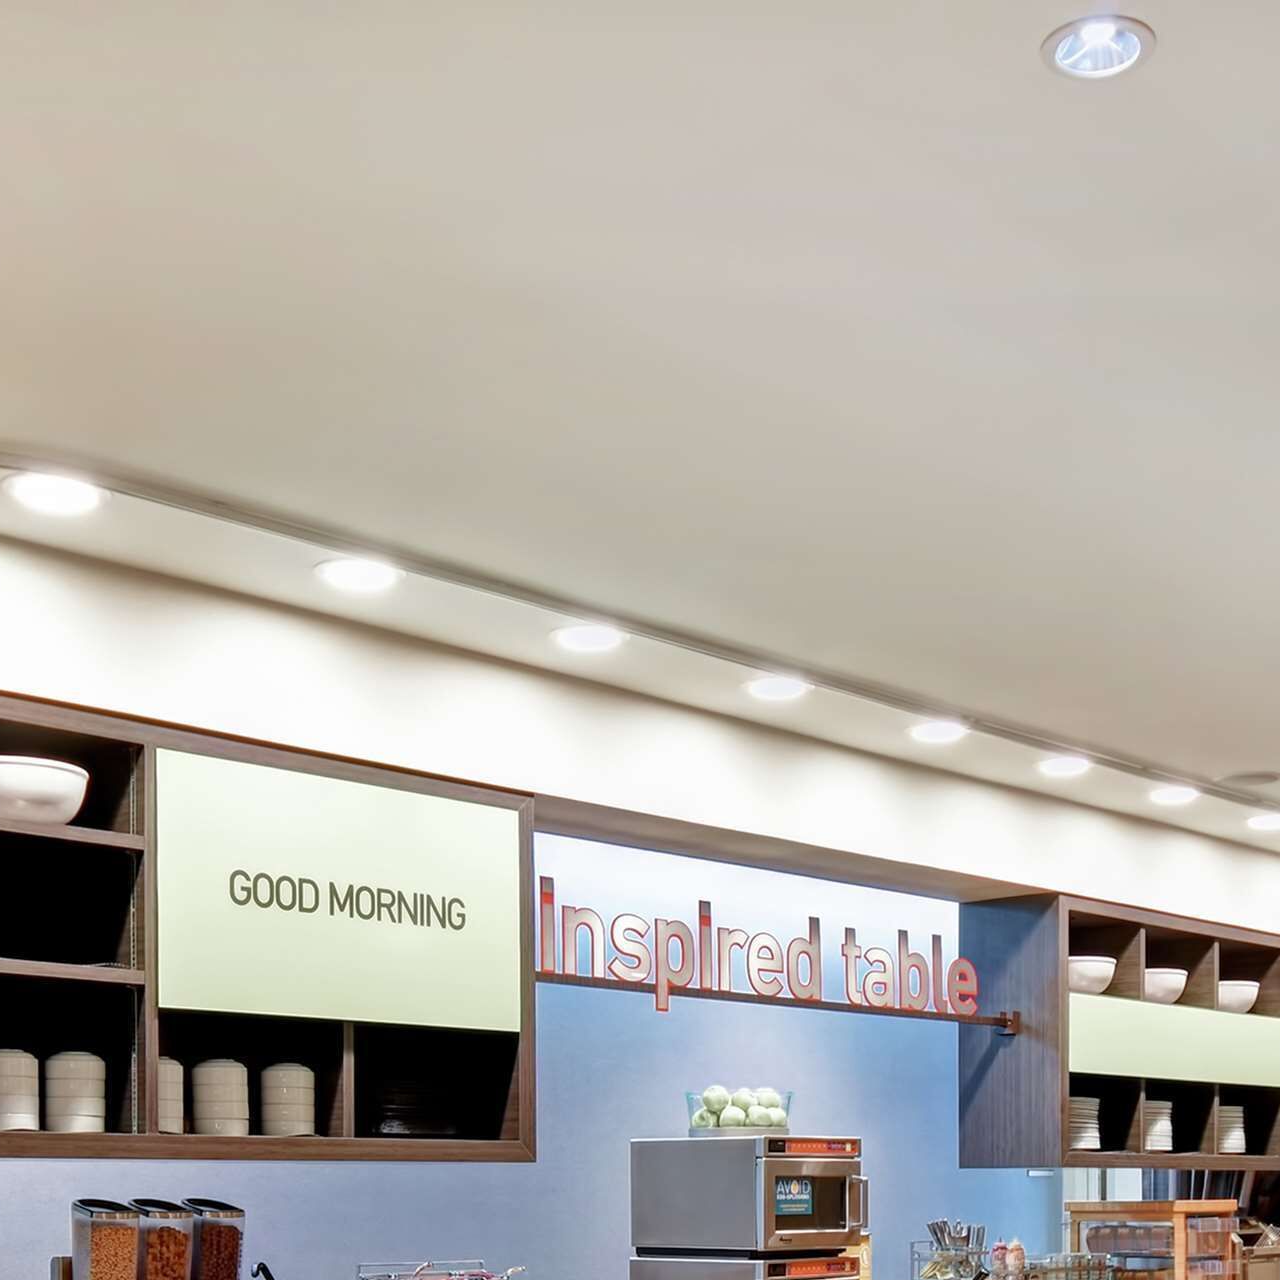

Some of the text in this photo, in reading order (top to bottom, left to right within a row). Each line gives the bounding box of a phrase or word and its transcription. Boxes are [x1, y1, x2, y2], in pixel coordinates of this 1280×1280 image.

[228, 869, 467, 931] GOOD MORNING
[841, 927, 980, 1017] table
